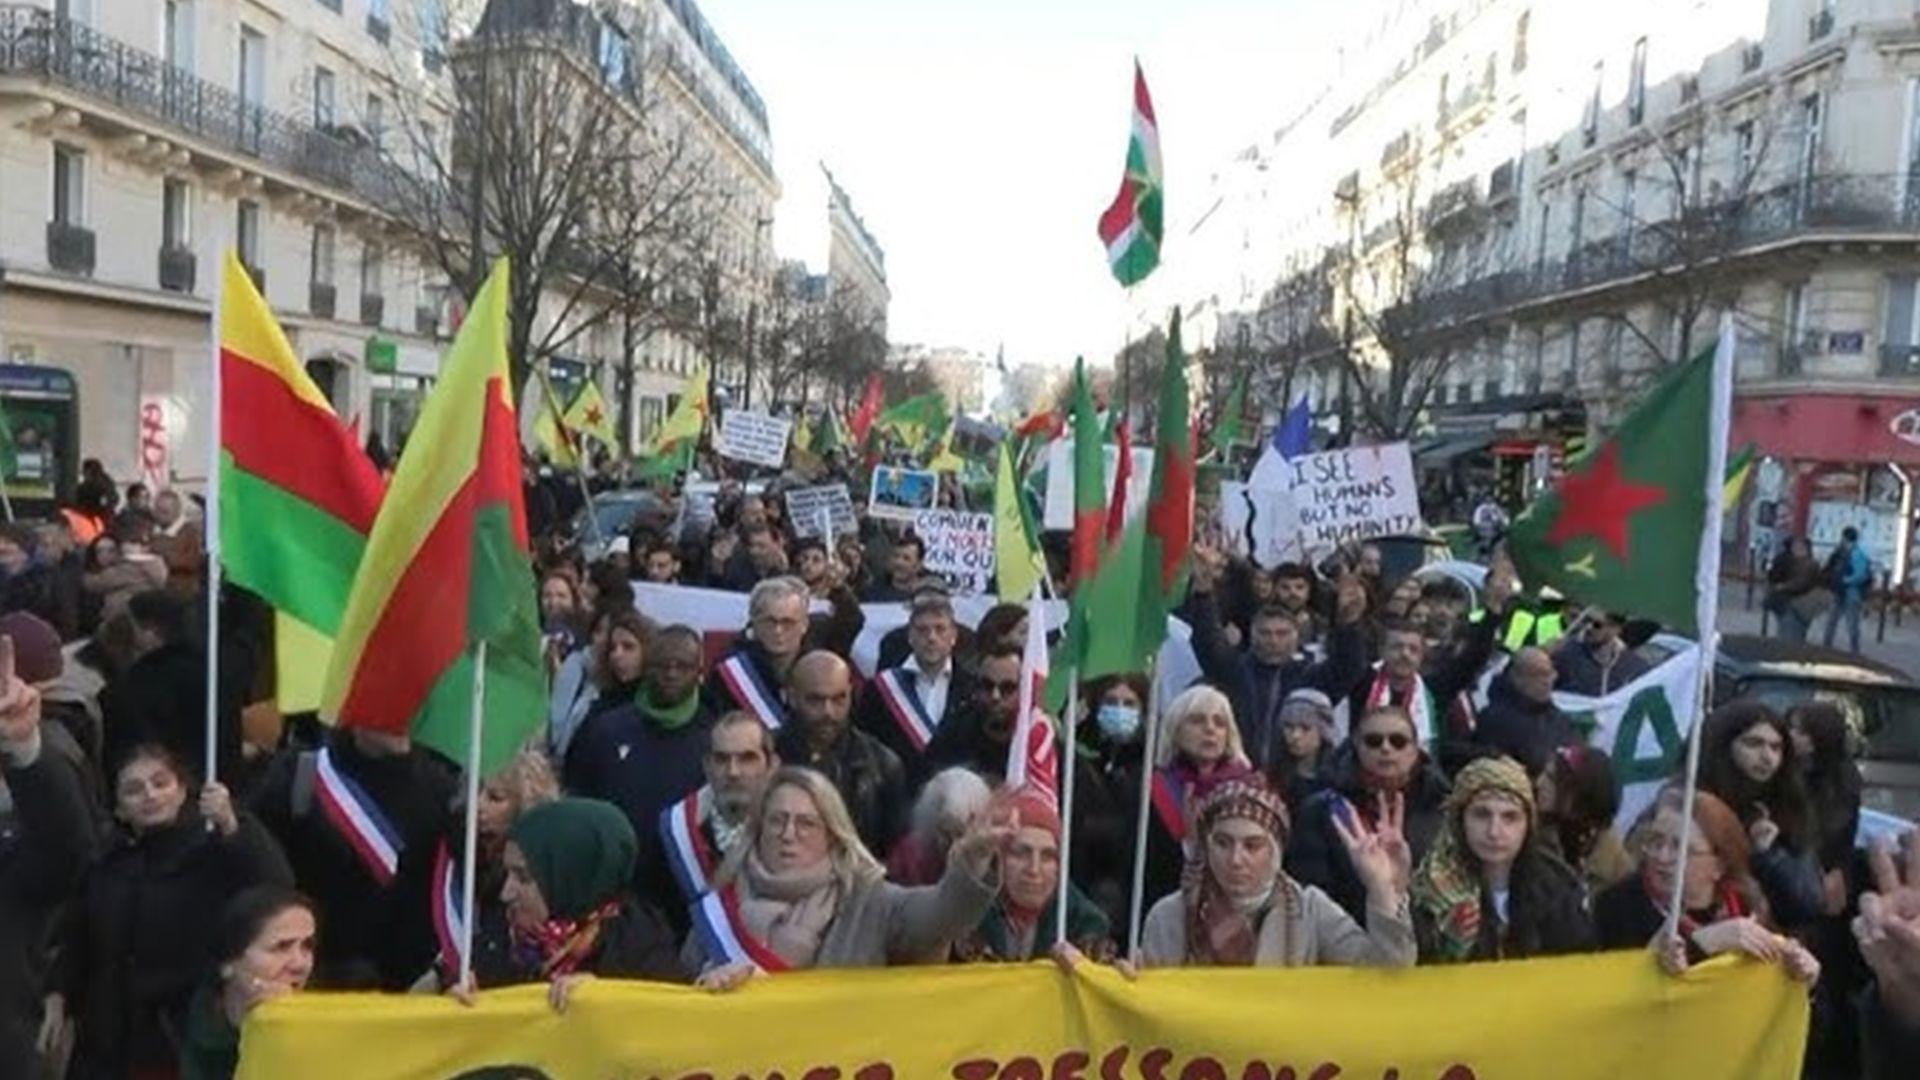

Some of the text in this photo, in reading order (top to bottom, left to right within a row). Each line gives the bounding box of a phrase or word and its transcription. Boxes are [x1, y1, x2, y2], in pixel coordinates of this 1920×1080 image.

[1294, 452, 1356, 485] I SEE
[1300, 501, 1373, 525] BUT NO
